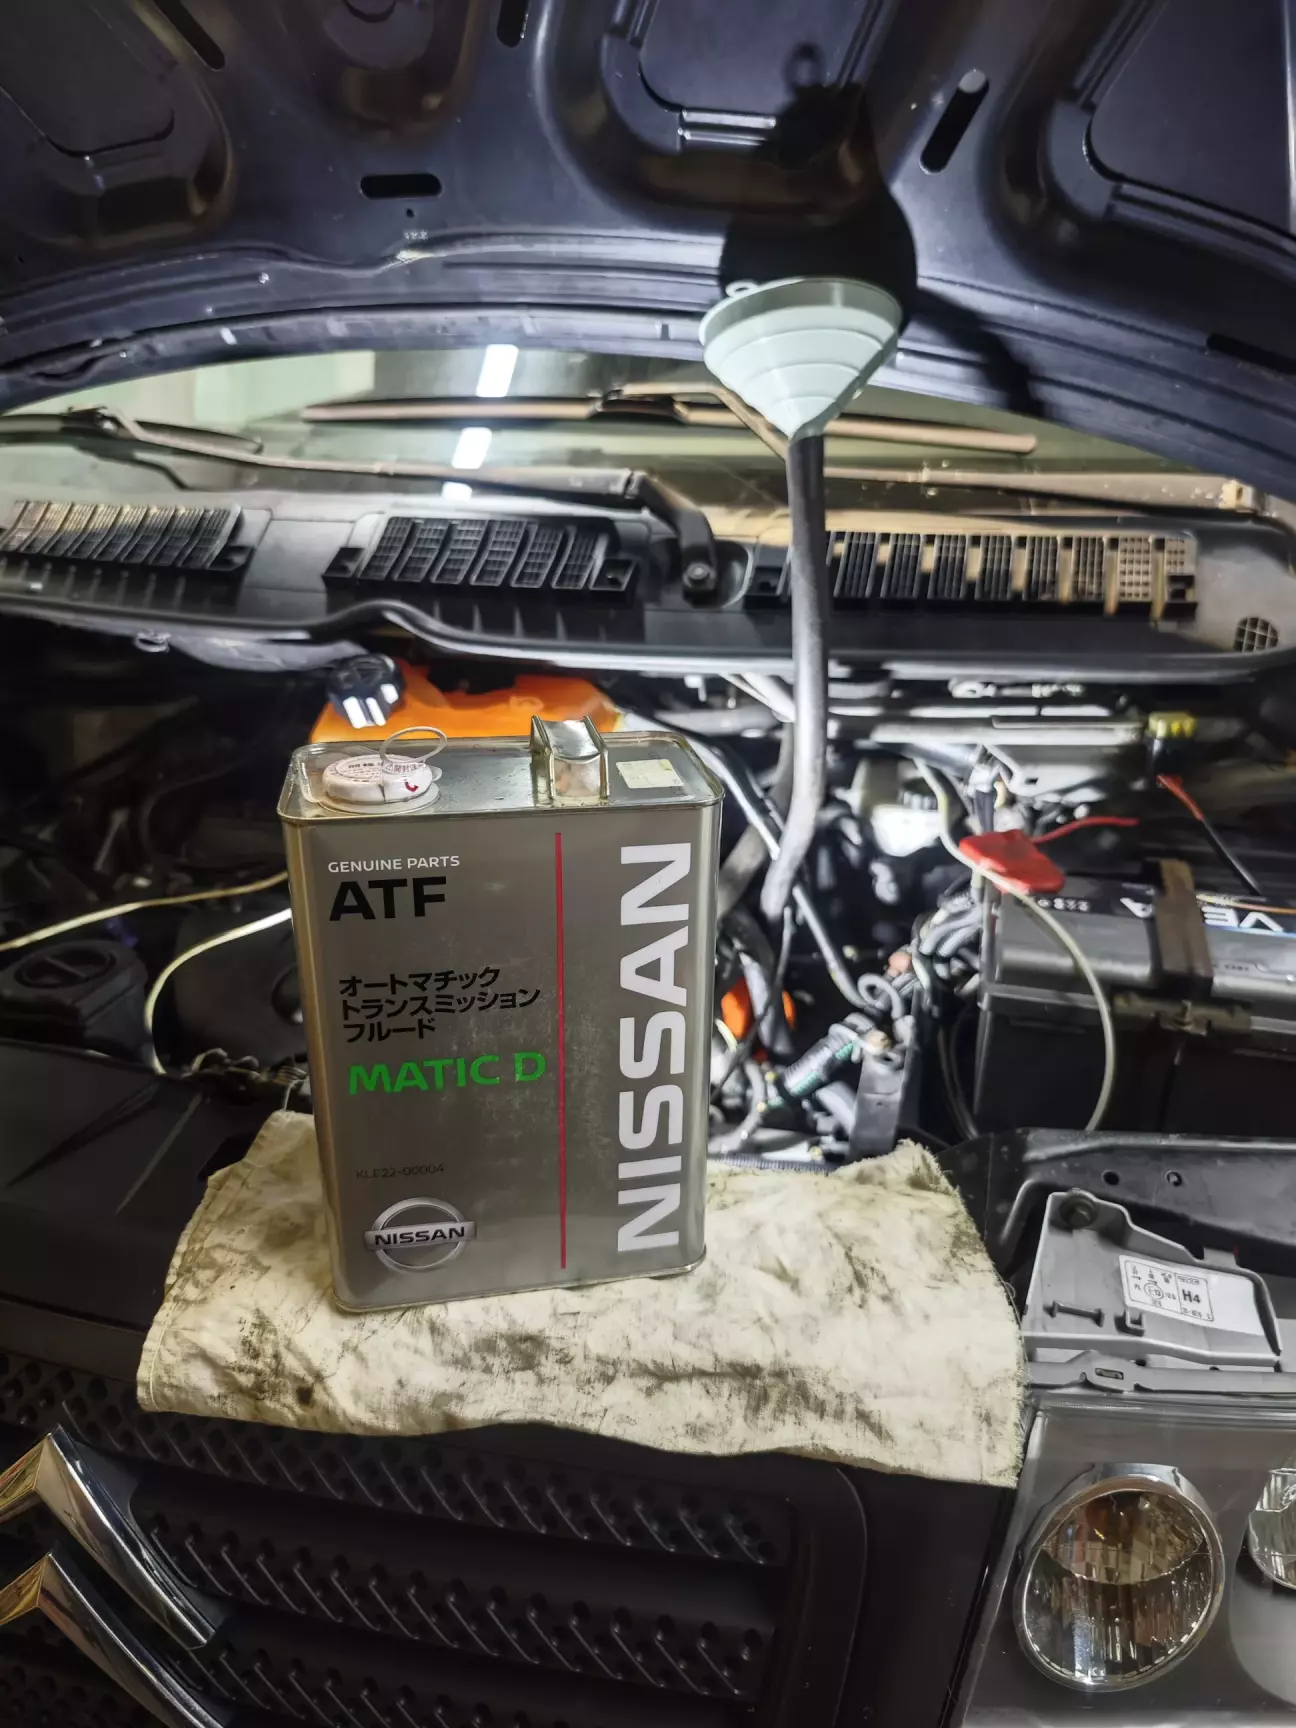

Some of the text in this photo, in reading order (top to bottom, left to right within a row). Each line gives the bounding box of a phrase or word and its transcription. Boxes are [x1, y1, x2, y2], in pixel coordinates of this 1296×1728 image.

[328, 855, 460, 873] GENUINE PARTS
[329, 875, 447, 921] ATF
[339, 966, 500, 997] オートマチック
[342, 988, 541, 1021] トランスミッション
[343, 1017, 436, 1043] フルード
[617, 842, 691, 1252] NISSAN
[349, 1051, 546, 1095] MATIC D
[356, 1163, 445, 1179] KLE22-00004
[374, 1226, 465, 1246] NISSAN
[1181, 1288, 1201, 1304] H4
